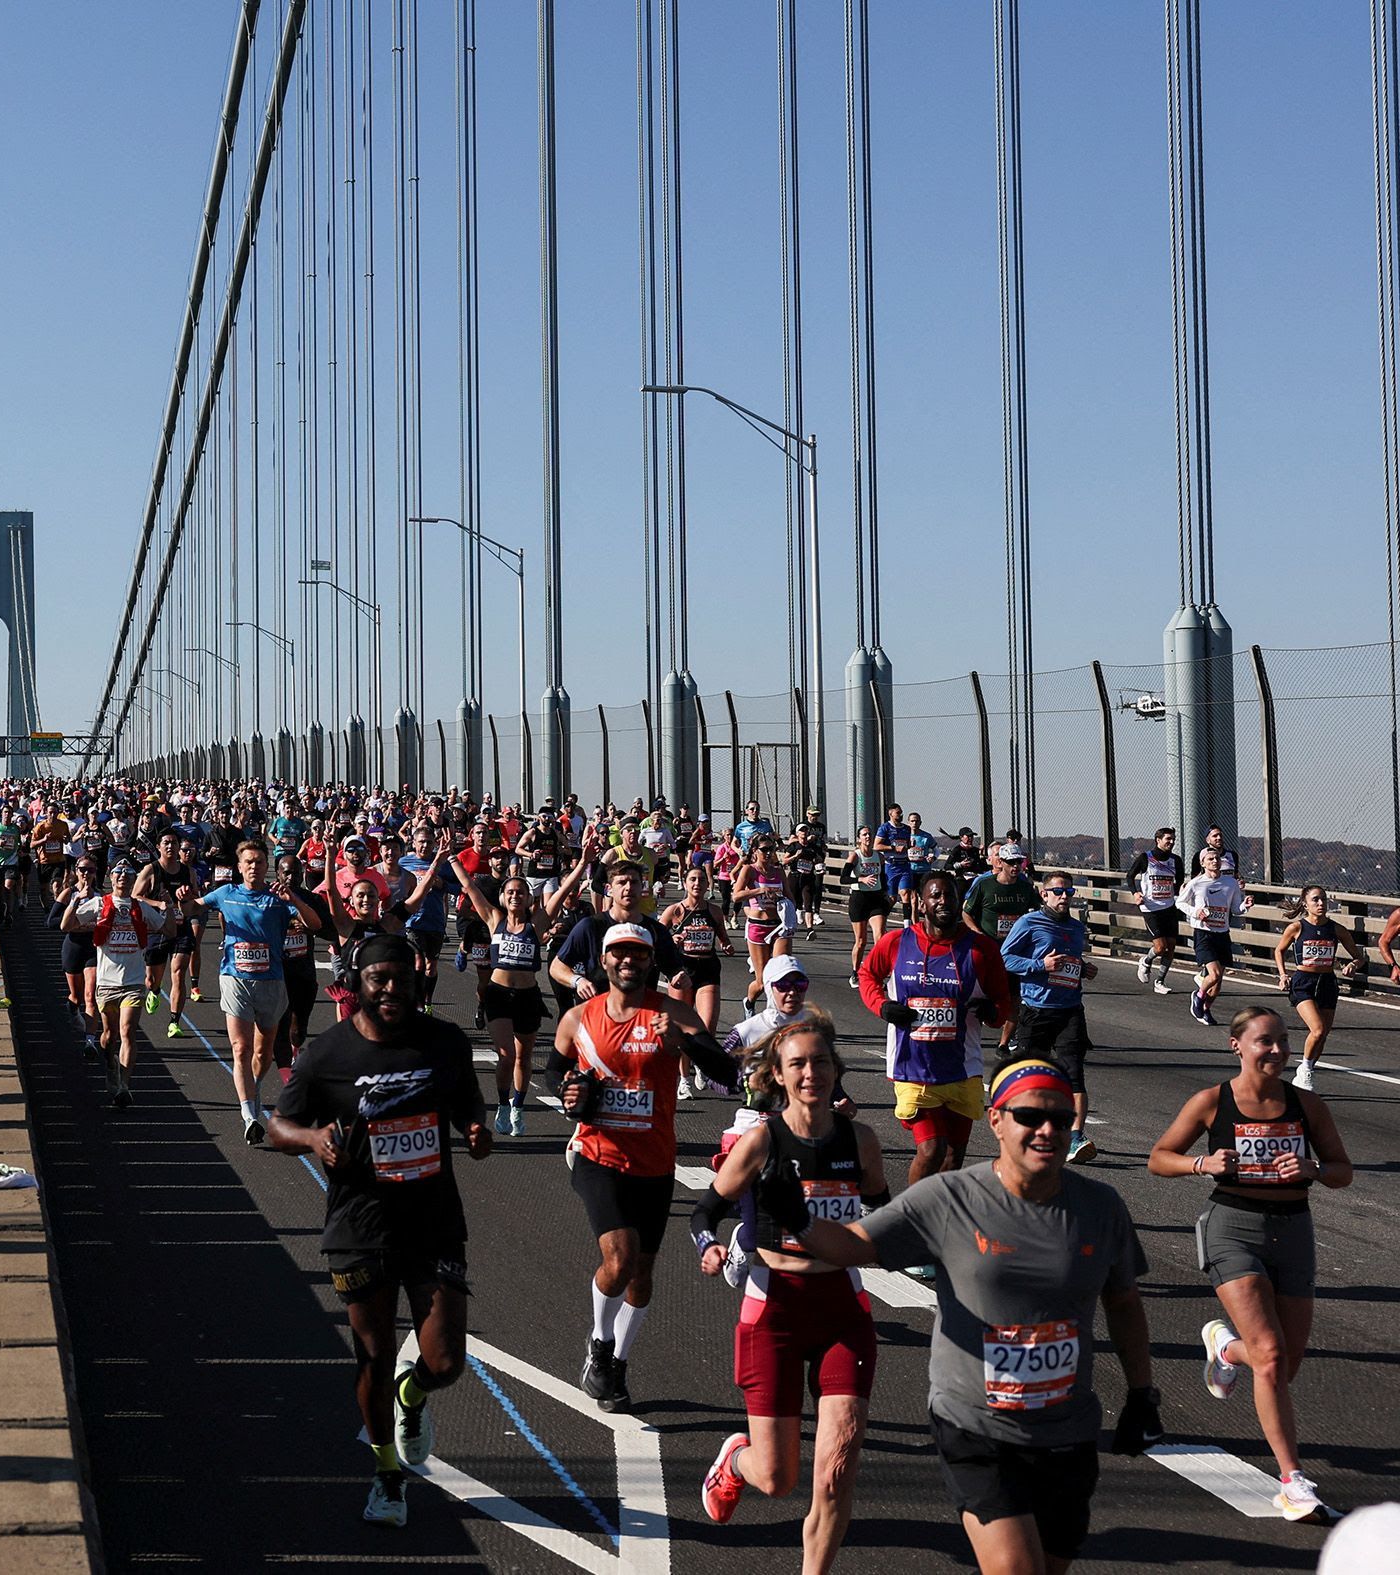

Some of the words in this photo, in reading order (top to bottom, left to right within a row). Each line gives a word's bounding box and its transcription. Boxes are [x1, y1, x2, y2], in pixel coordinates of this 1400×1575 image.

[691, 918, 707, 926] JESS
[110, 931, 136, 941] 27726
[285, 935, 304, 945] 7118
[502, 942, 532, 955] 29135
[1306, 946, 1333, 956] 29571
[236, 950, 268, 960] 29904
[919, 1009, 954, 1022] 7860
[620, 1042, 638, 1053] NEW
[639, 1042, 658, 1053] YORK
[354, 1069, 432, 1087] NIKE
[605, 1089, 650, 1109] 9954
[1244, 1126, 1261, 1136] tcs
[375, 1129, 436, 1156] 27909
[1241, 1138, 1302, 1158] 29997
[831, 1160, 855, 1169] BANDIT
[808, 1199, 856, 1221] 0134
[993, 1342, 1074, 1373] 27502
